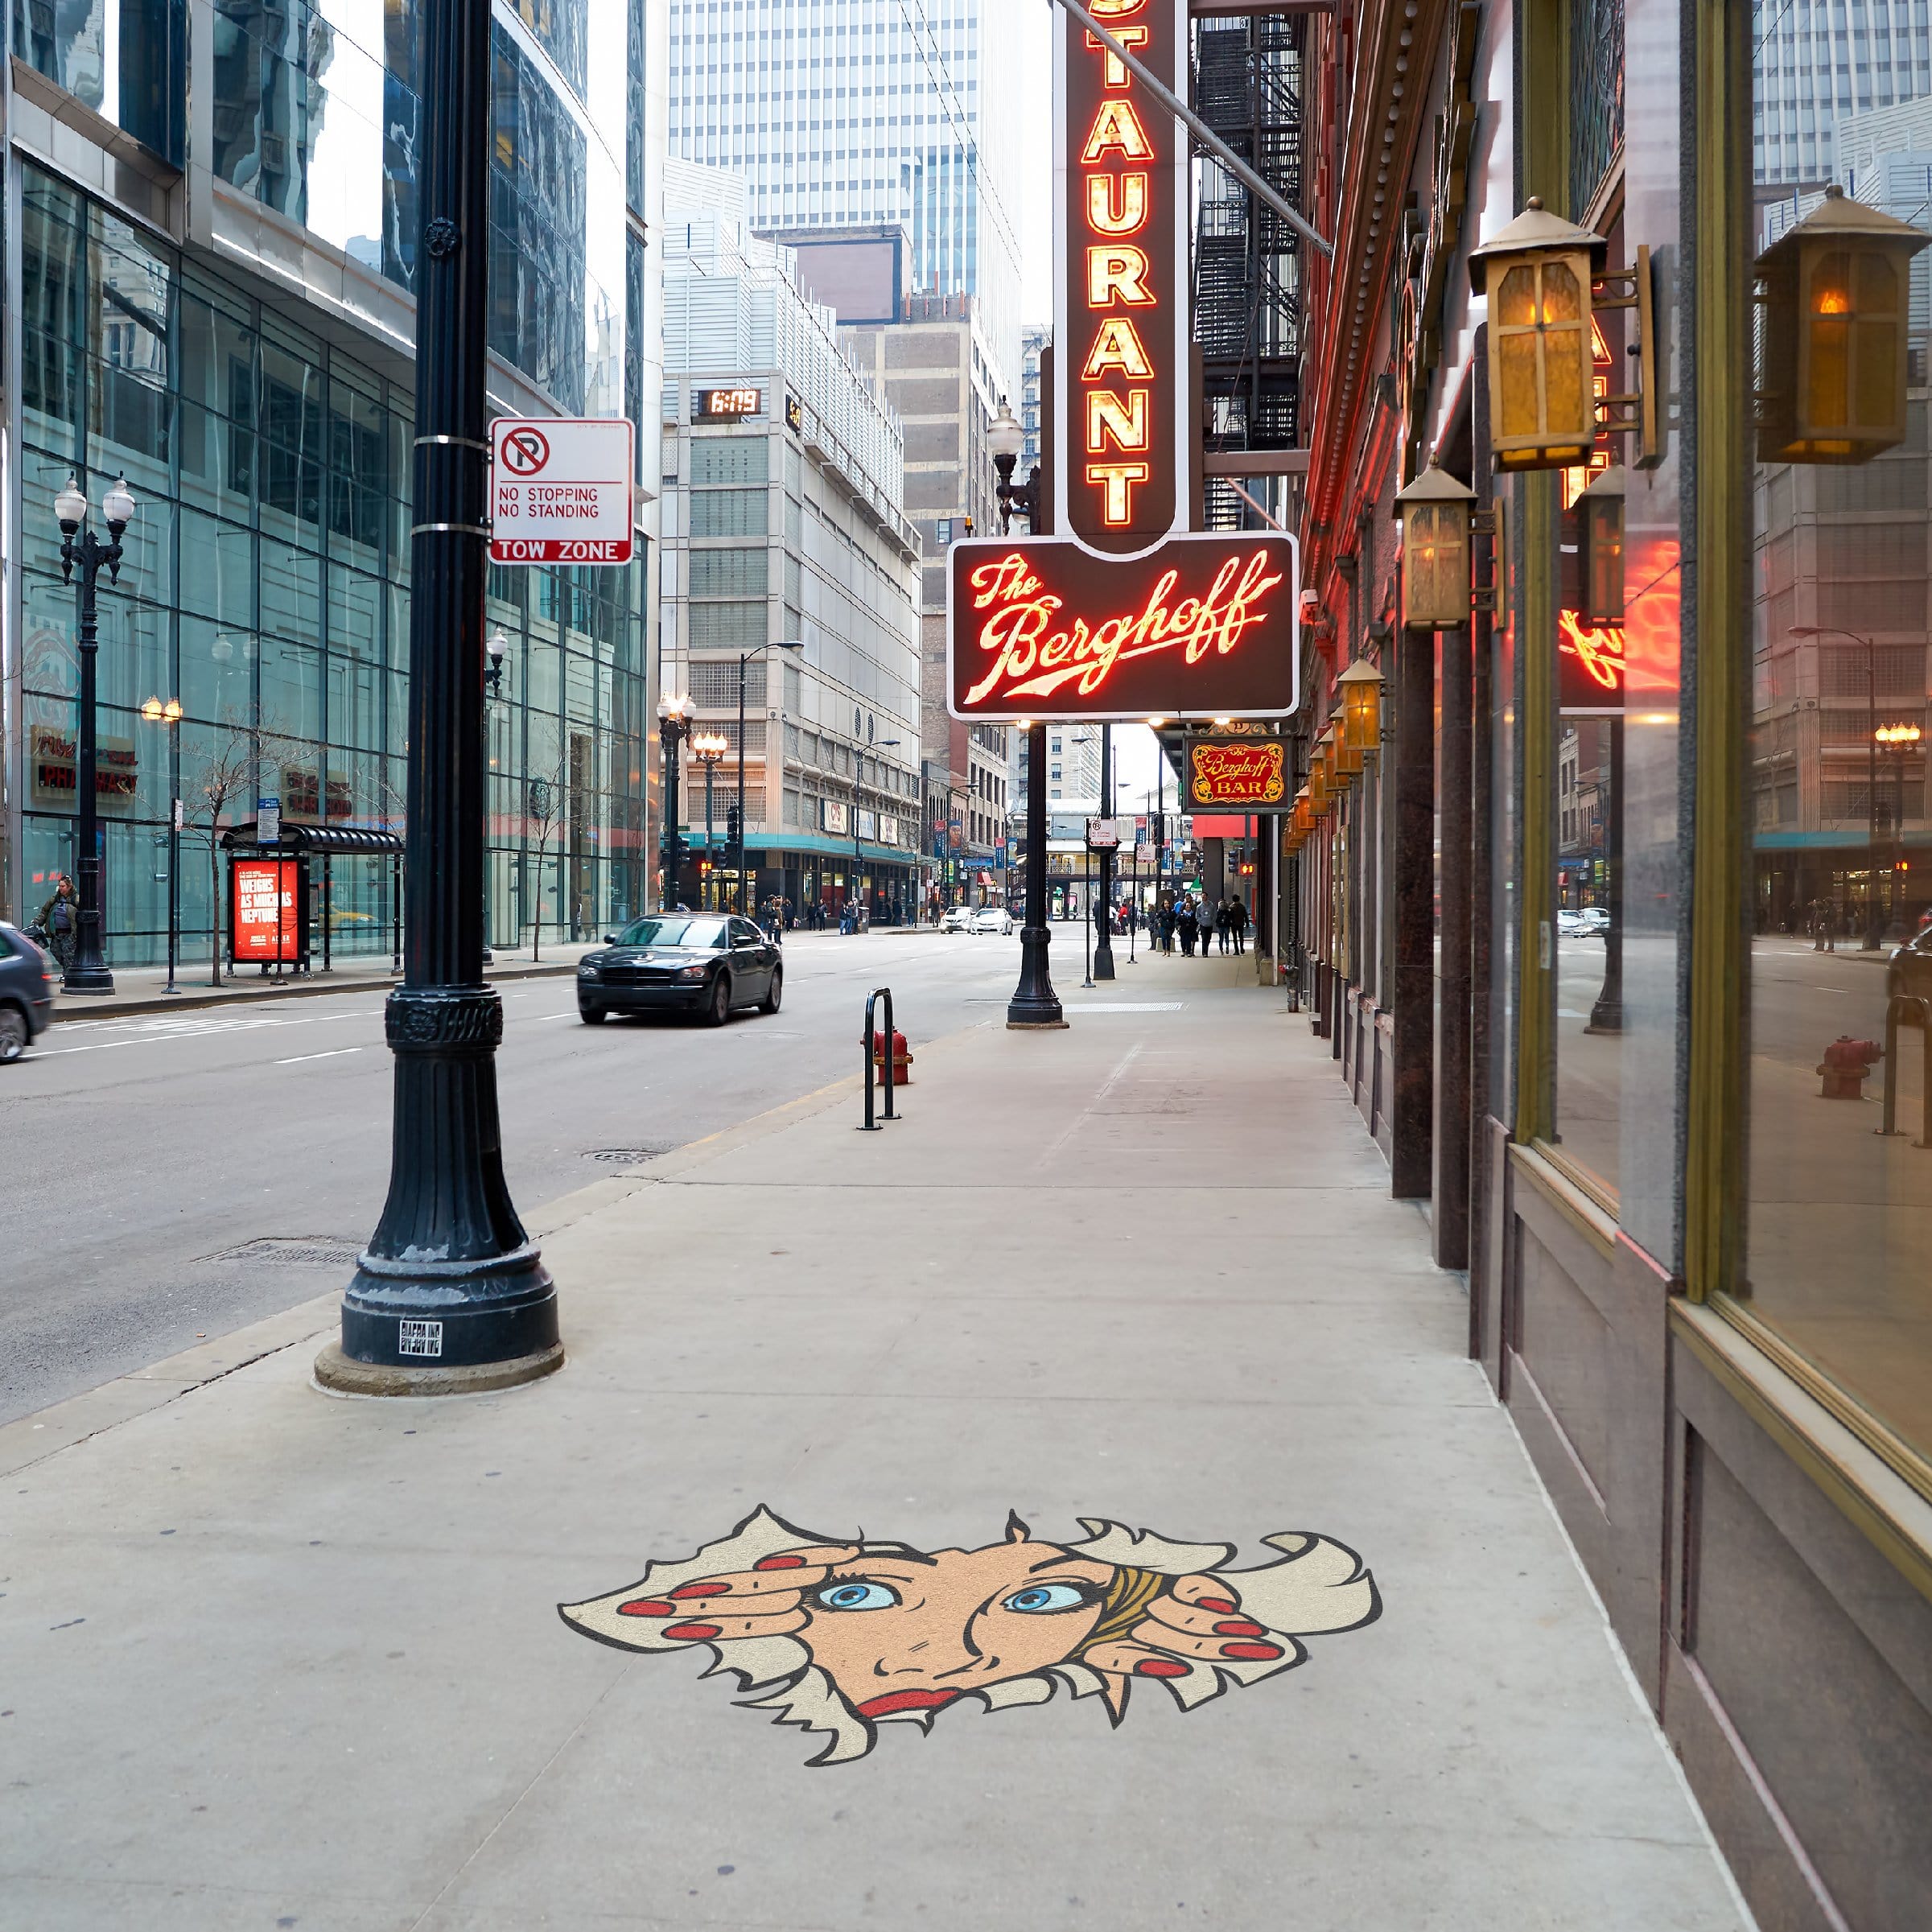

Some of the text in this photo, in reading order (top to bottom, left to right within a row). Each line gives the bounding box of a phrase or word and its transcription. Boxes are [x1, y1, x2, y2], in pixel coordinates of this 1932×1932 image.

[1081, 0, 1156, 526] TAURANT
[499, 488, 598, 502] NO STOPPING
[499, 504, 599, 518] NO STANDING
[498, 541, 619, 559] TOW ZONE
[970, 553, 1044, 608] The
[962, 549, 1283, 706] Berghoff
[1205, 752, 1273, 781] Berghoff
[1217, 781, 1262, 794] BAR
[241, 893, 252, 908] AS
